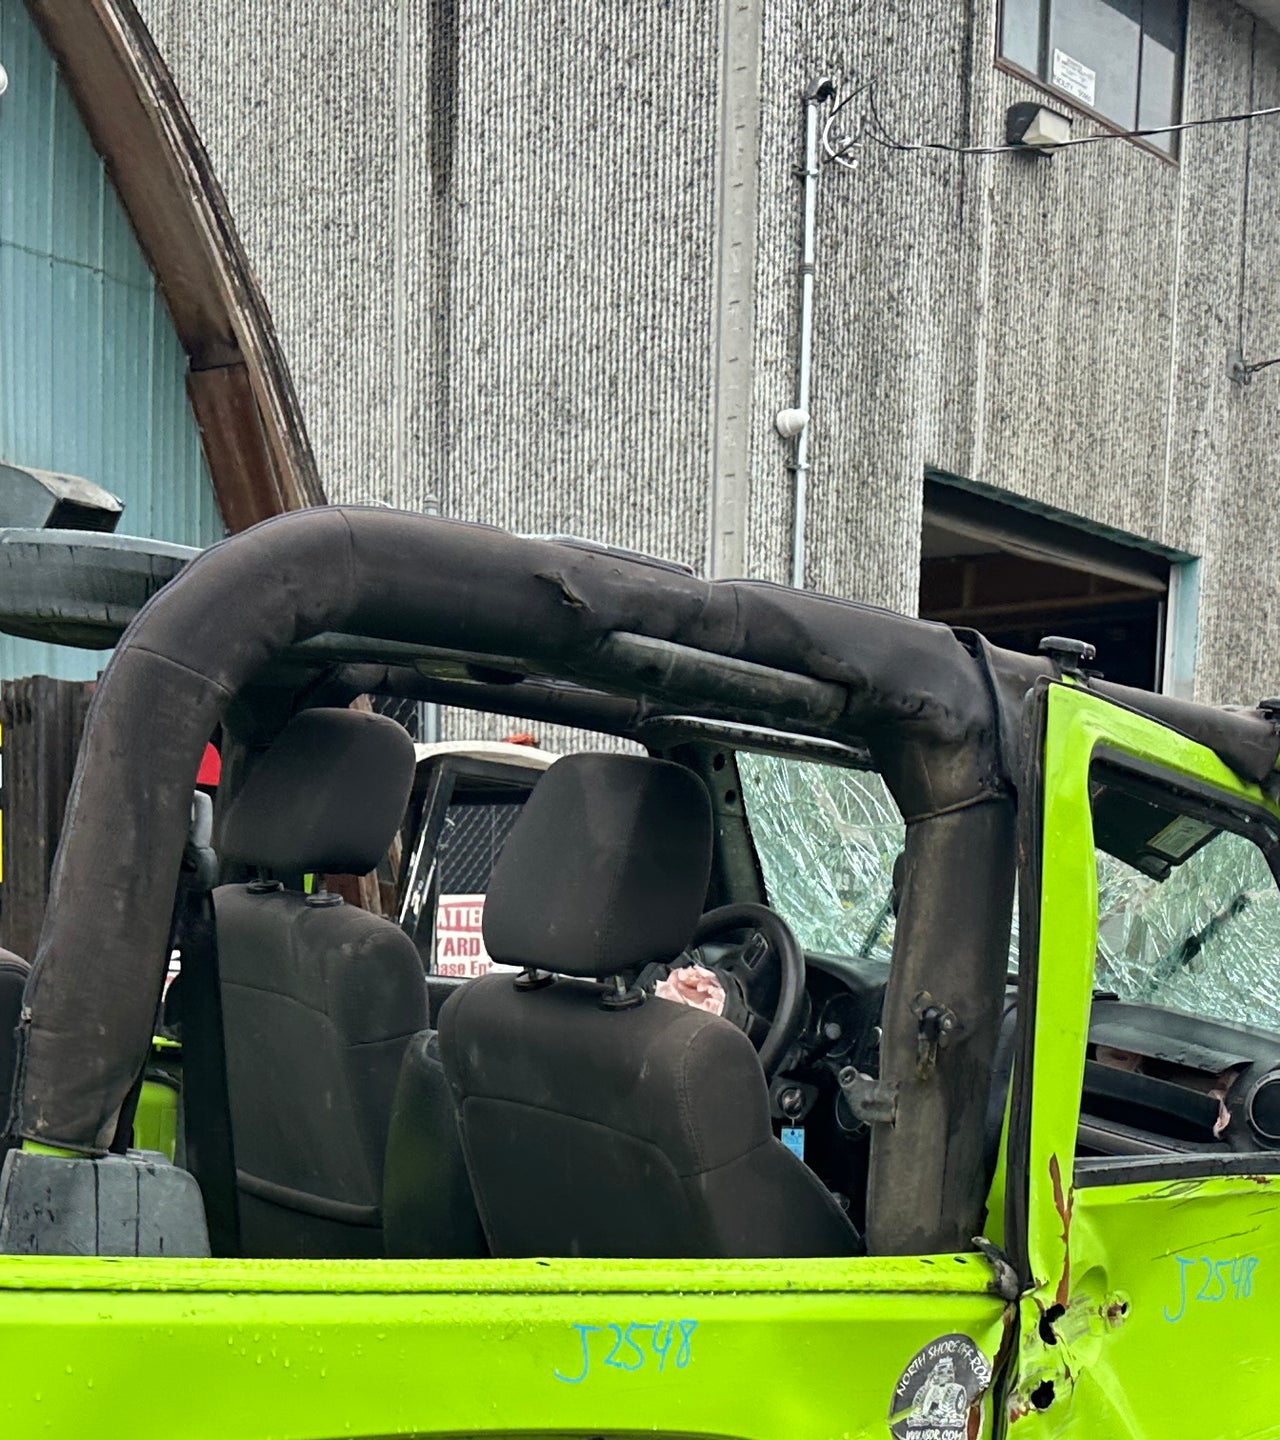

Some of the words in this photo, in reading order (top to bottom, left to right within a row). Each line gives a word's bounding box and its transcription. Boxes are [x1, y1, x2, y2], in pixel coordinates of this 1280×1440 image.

[437, 907, 481, 927] ATTE
[1162, 1256, 1259, 1323] J2548
[554, 1320, 698, 1384] J2548
[896, 1353, 926, 1397] NORTH
